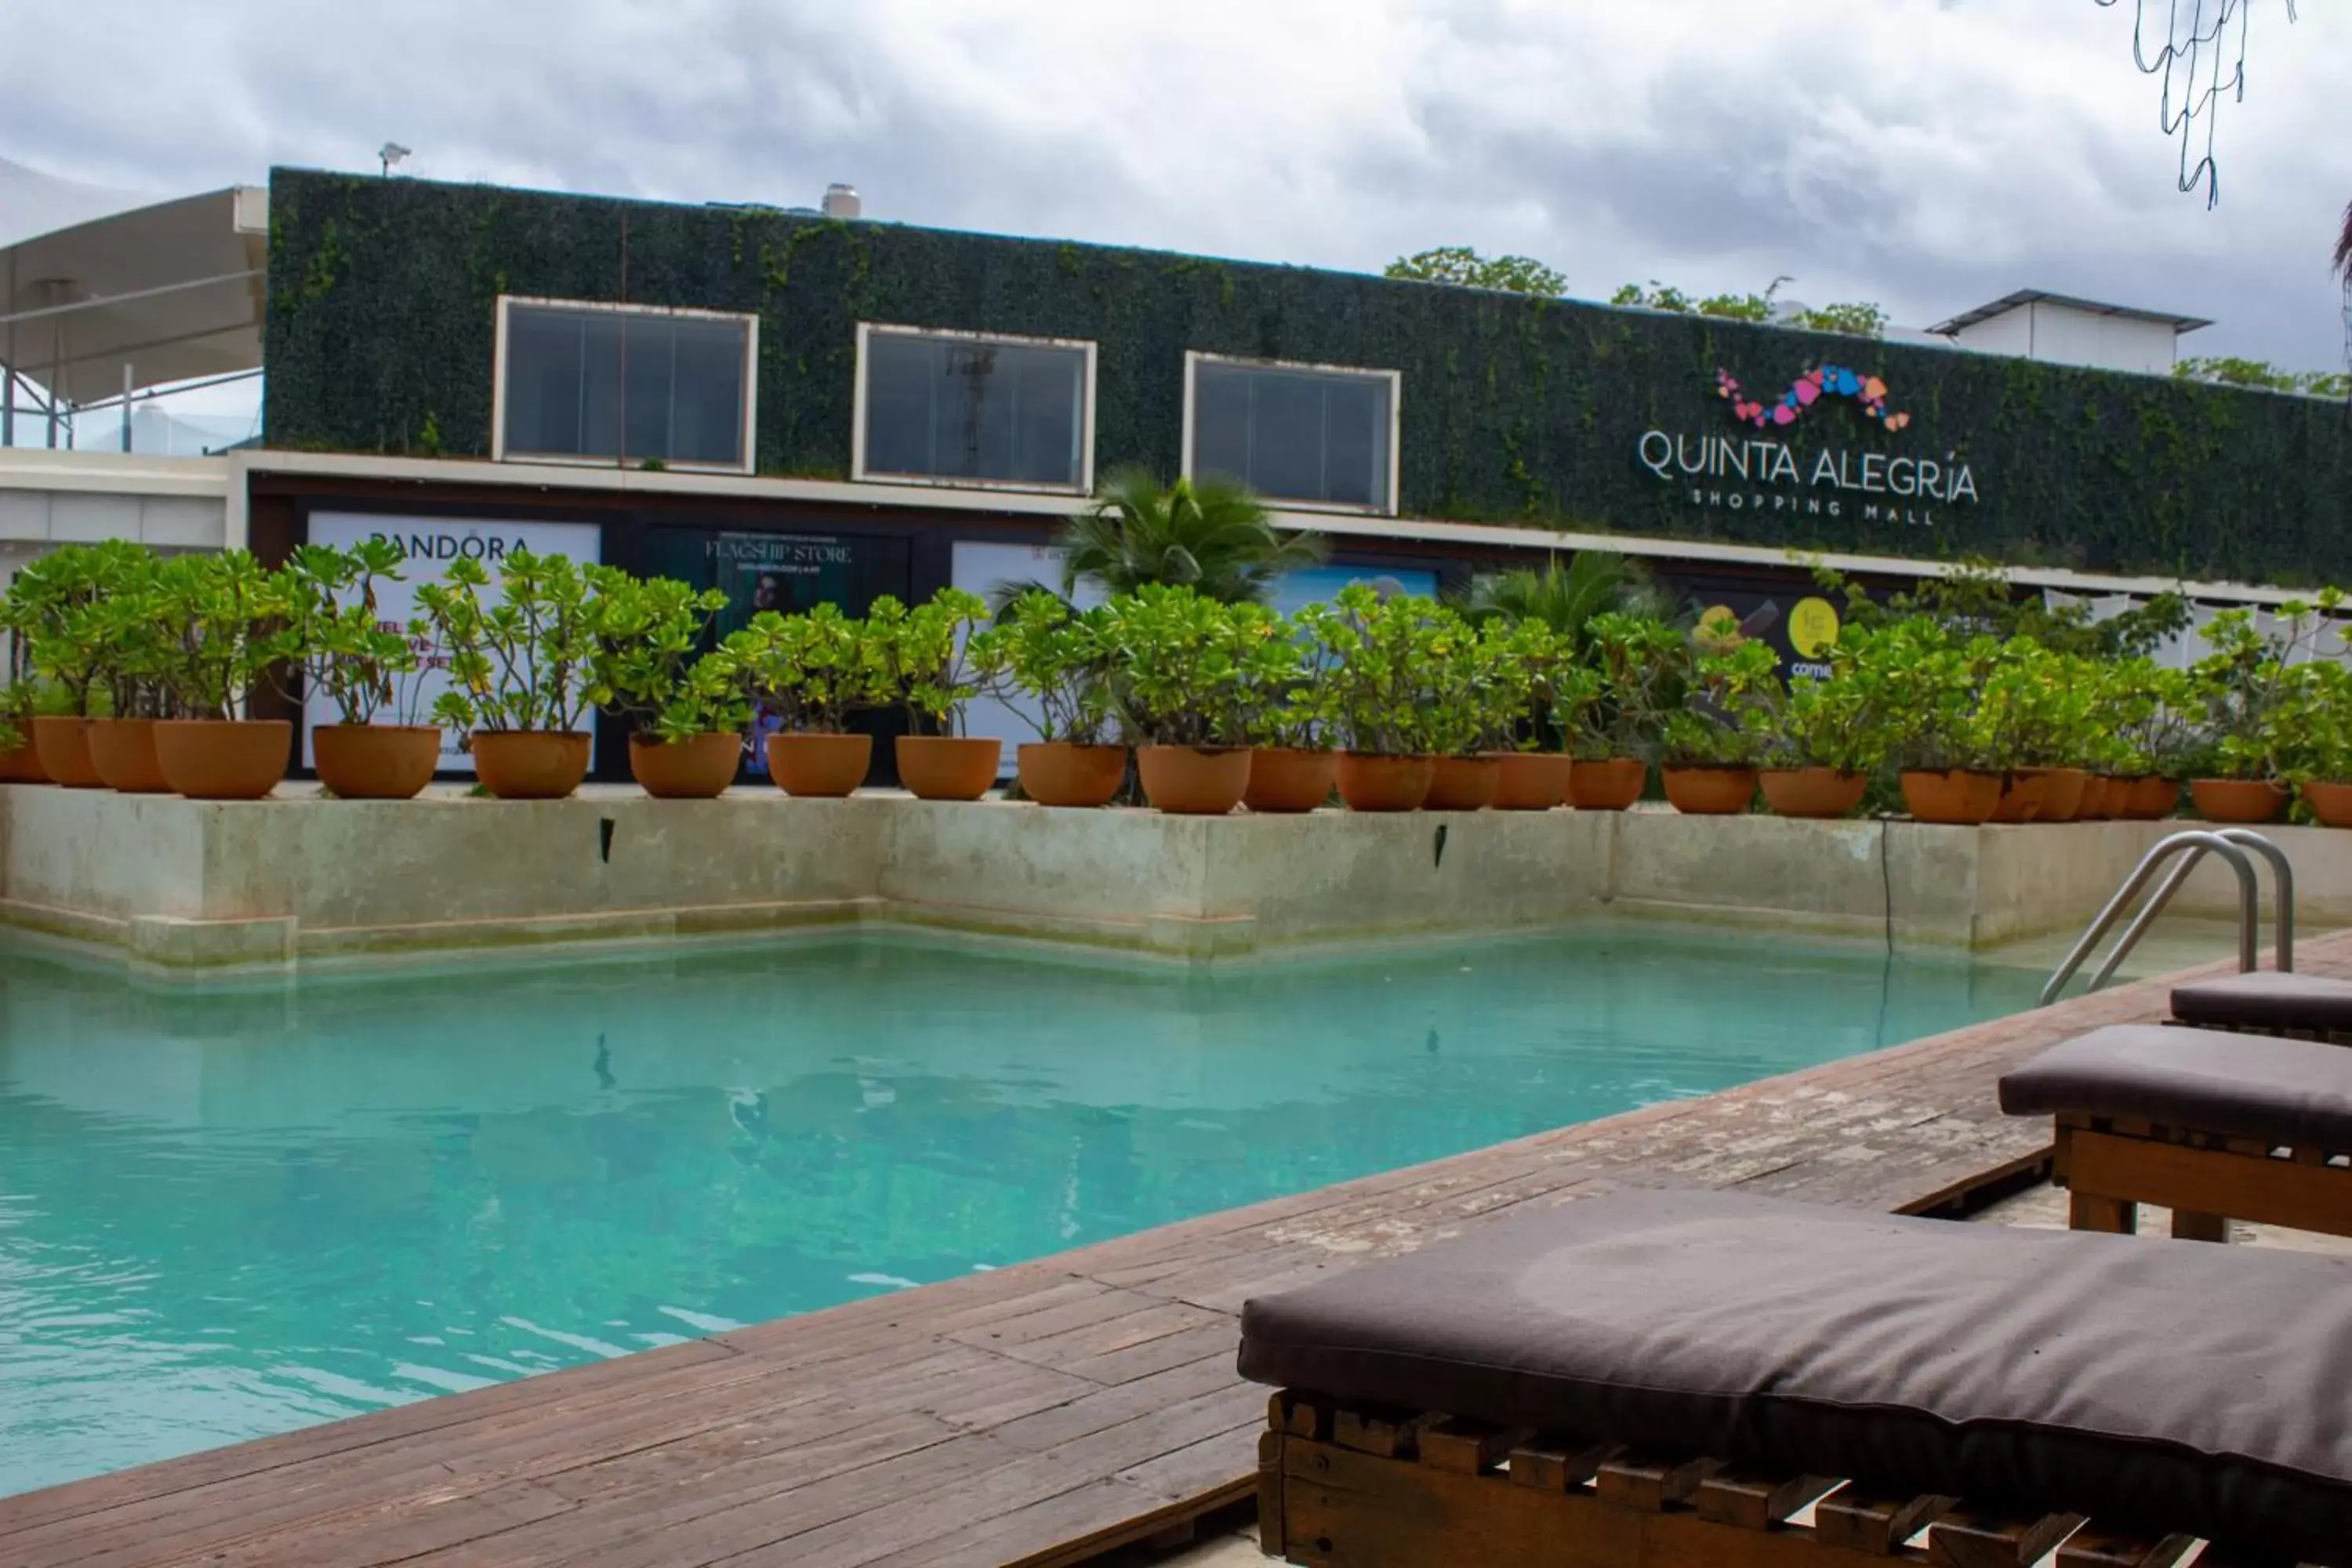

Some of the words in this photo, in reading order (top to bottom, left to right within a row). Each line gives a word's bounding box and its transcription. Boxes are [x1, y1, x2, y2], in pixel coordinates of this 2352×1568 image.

[1639, 430, 1800, 484] QUINTA
[1811, 446, 1979, 503] ALEGRÍA
[1693, 488, 1841, 517] SHOPPING
[1864, 503, 1933, 525] MALL
[793, 544, 852, 564] STORE
